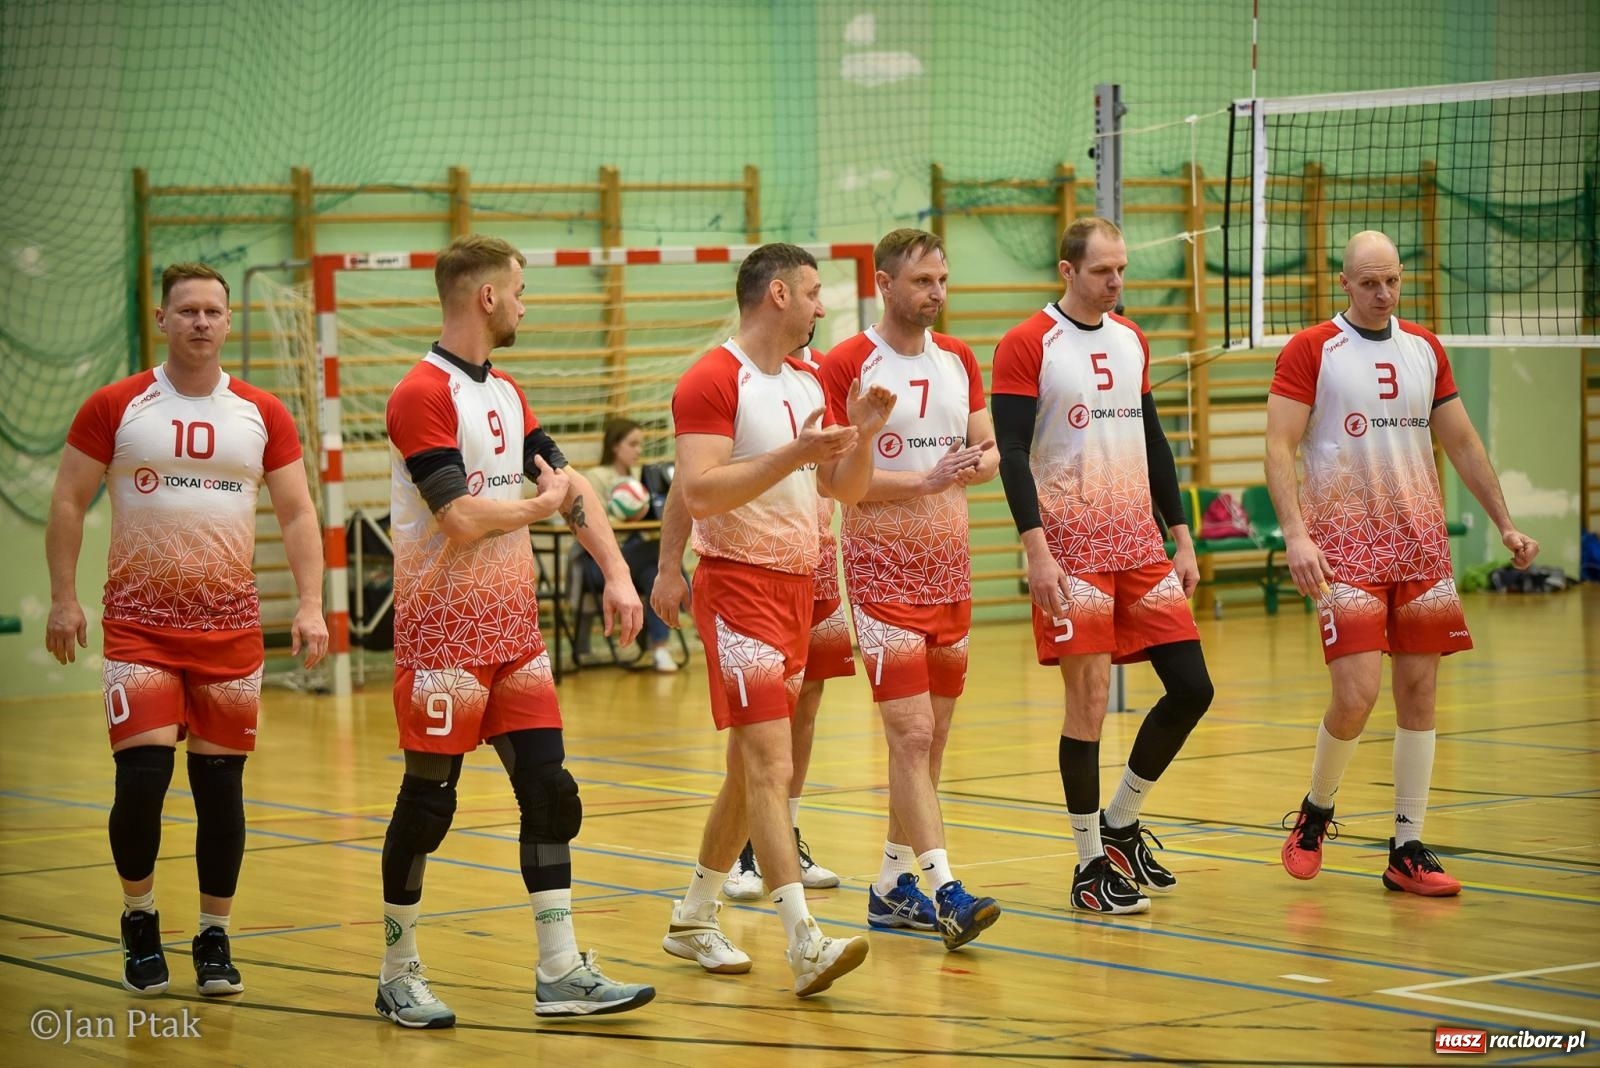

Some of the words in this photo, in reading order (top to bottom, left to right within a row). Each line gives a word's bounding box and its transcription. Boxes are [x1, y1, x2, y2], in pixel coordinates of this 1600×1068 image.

[1090, 353, 1114, 391] 5
[1374, 362, 1399, 400] 3
[909, 379, 930, 419] 7
[1091, 409, 1115, 419] TOKAI
[1117, 408, 1142, 418] COBE
[487, 410, 506, 455] 9
[782, 400, 798, 439] 1
[1370, 418, 1397, 428] TOKAI
[171, 419, 215, 460] 10
[907, 436, 937, 449] TOKAI
[163, 476, 201, 489] TOKAI
[203, 479, 243, 493] COBEX
[1321, 608, 1338, 647] 3
[866, 646, 885, 686] 7
[732, 667, 748, 708] 1
[425, 692, 453, 737] 9
